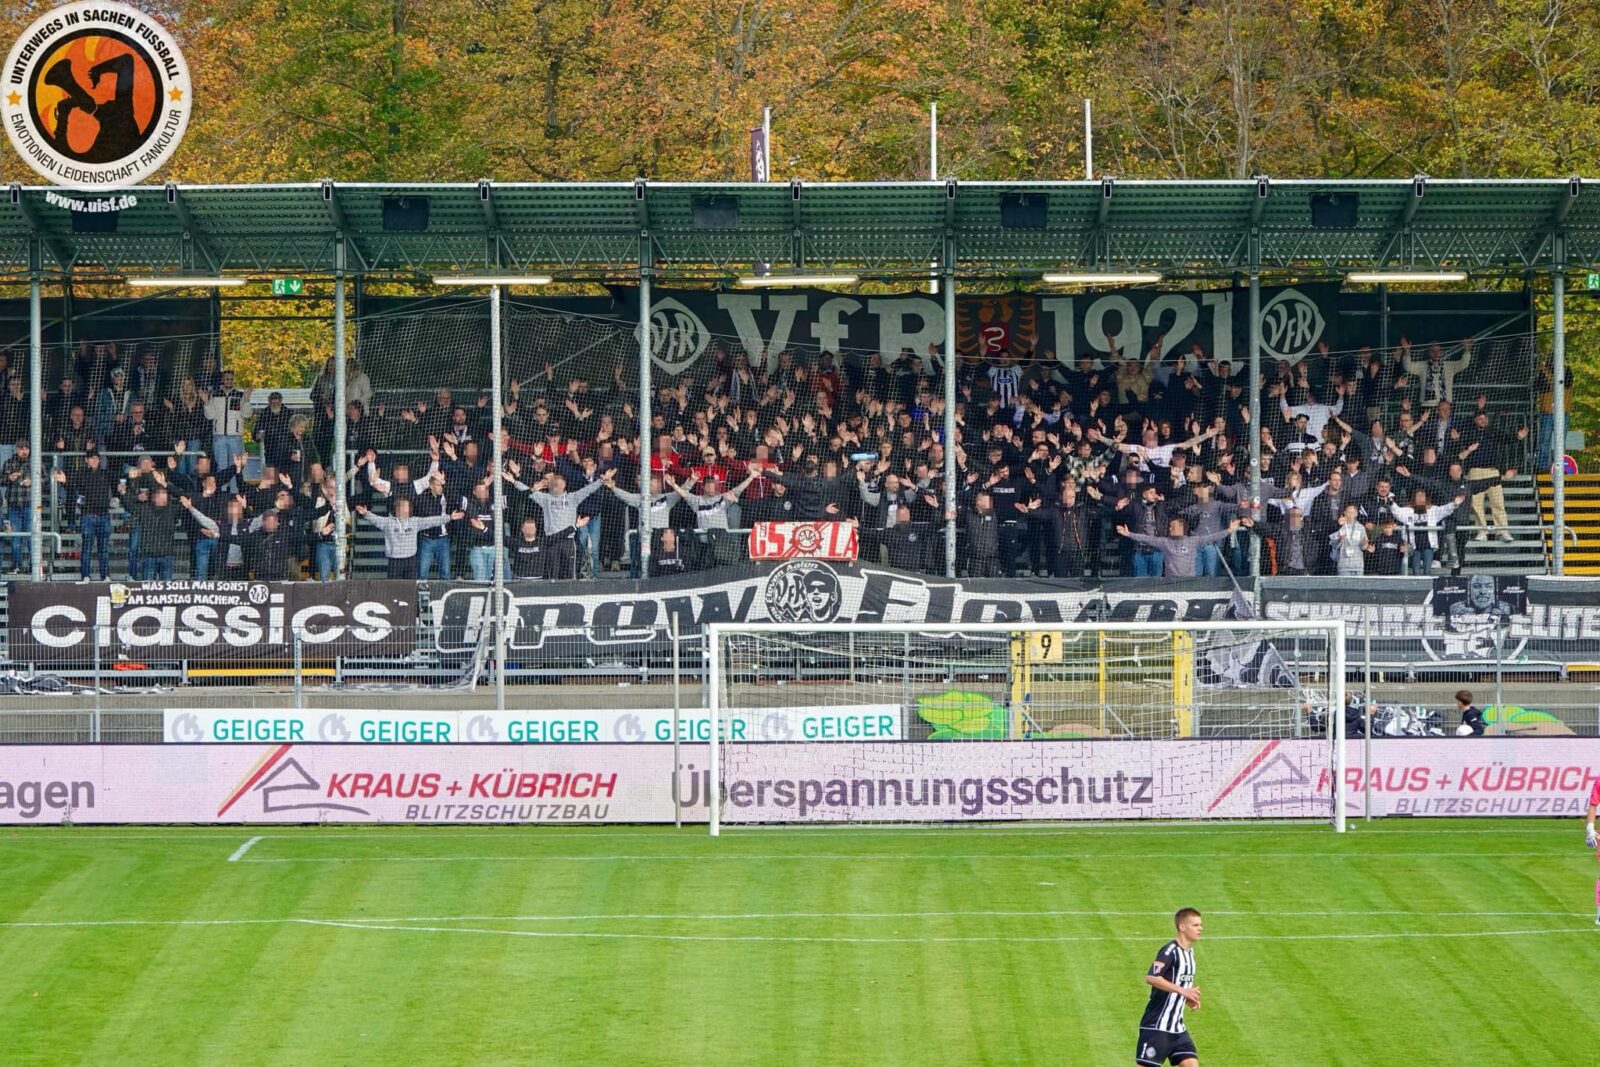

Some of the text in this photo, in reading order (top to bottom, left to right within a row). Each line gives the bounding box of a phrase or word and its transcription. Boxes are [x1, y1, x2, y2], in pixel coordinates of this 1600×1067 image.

[717, 292, 1244, 376] VfR 1921
[128, 594, 144, 605] AM
[146, 594, 191, 604] SAMSTAG
[166, 581, 190, 591] SOLL
[192, 581, 214, 591] MAN
[216, 581, 249, 592] SONST
[31, 593, 392, 648] classics
[1041, 634, 1052, 659] 9
[213, 719, 304, 741] GEIGER
[360, 720, 451, 743] GEIGER
[507, 720, 599, 743] GEIGER
[655, 719, 746, 741] GEIGER
[802, 715, 894, 739] GEIGER
[327, 773, 440, 799] KRAUS
[469, 768, 617, 799] KÜBRICH
[671, 763, 1153, 815] Überspannungsschutz
[405, 803, 609, 820] BLITZSCHUTZBAU
